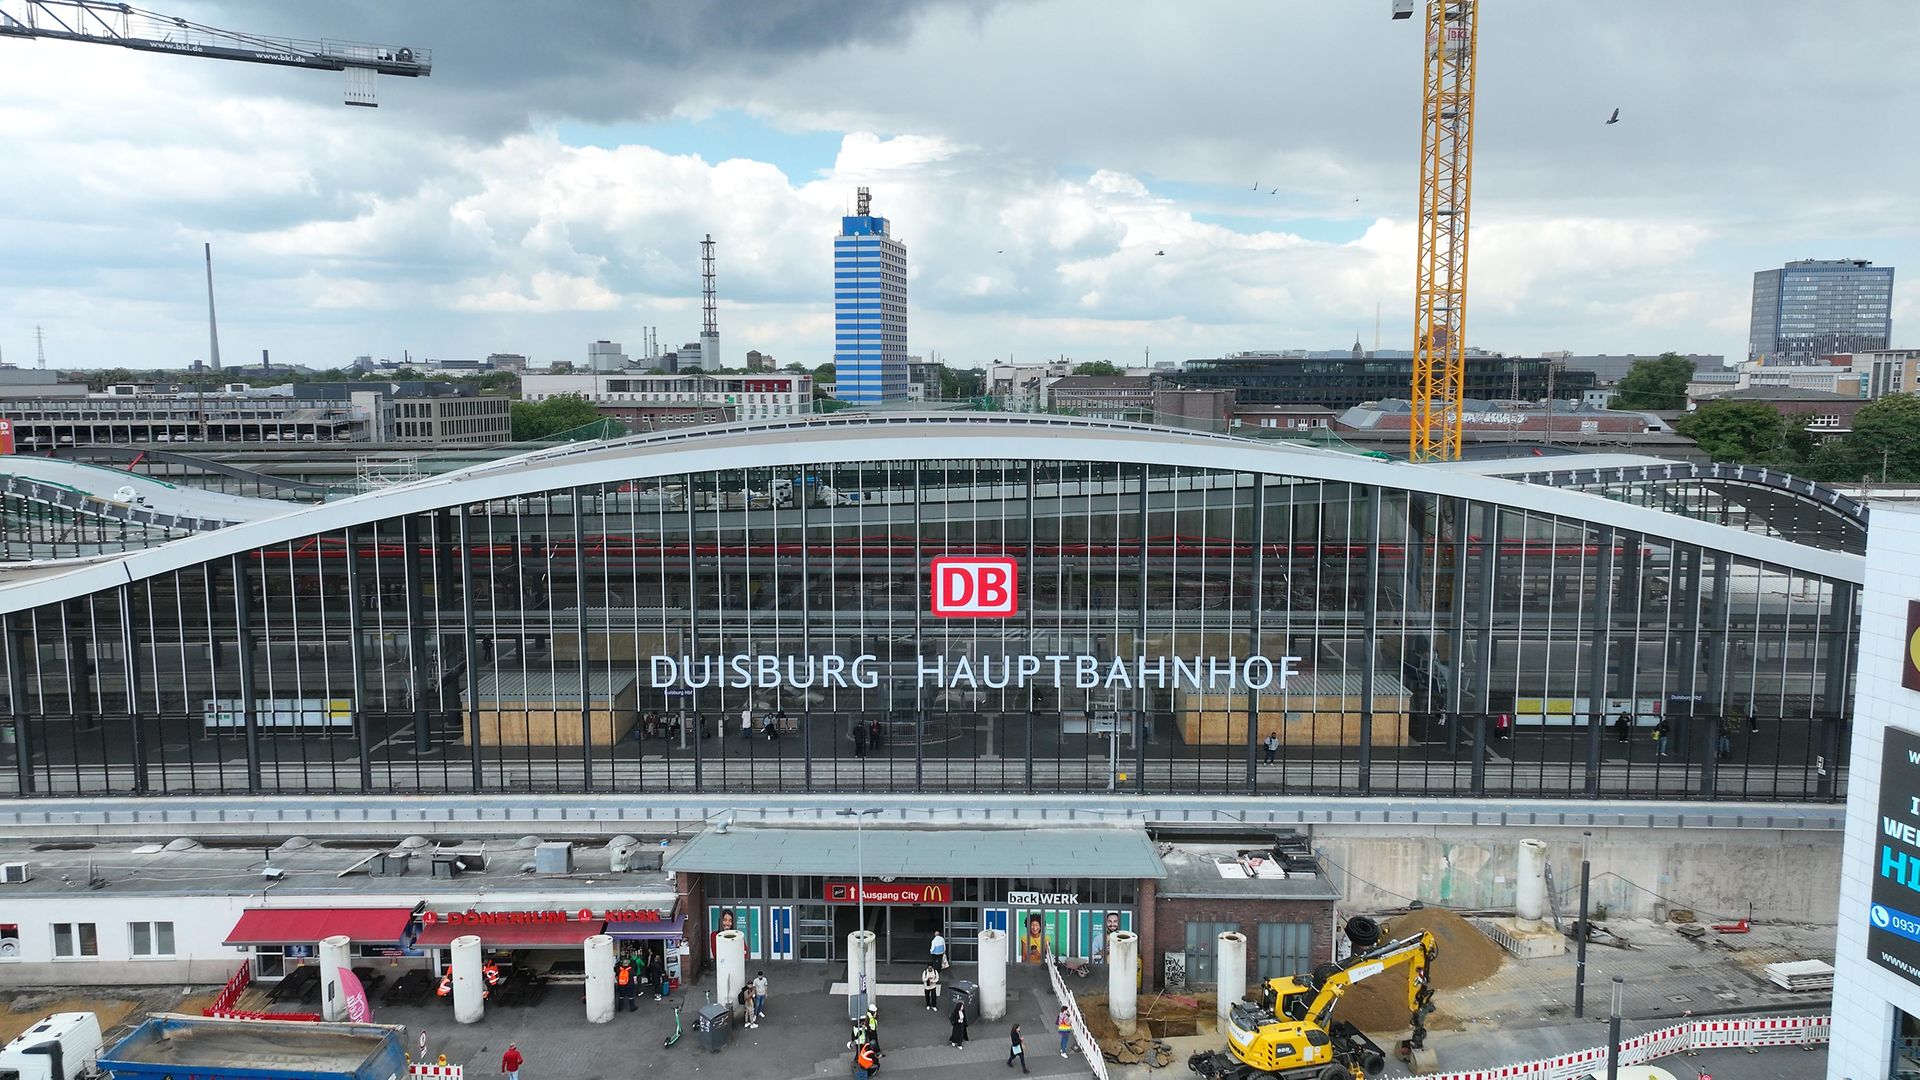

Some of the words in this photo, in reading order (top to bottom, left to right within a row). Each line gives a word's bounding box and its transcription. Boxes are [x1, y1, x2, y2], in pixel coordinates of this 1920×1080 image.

[150, 40, 203, 52] www.bkl.de
[255, 52, 306, 63] www.bkl.de
[942, 567, 1008, 607] DB
[651, 655, 879, 688] DUISBURG
[917, 655, 1302, 689] HAUPTBAHNHOF
[862, 891, 898, 901] Ausgang
[901, 890, 919, 901] City
[447, 908, 567, 926] DÖNERIUM
[605, 908, 661, 923] KIOSK
